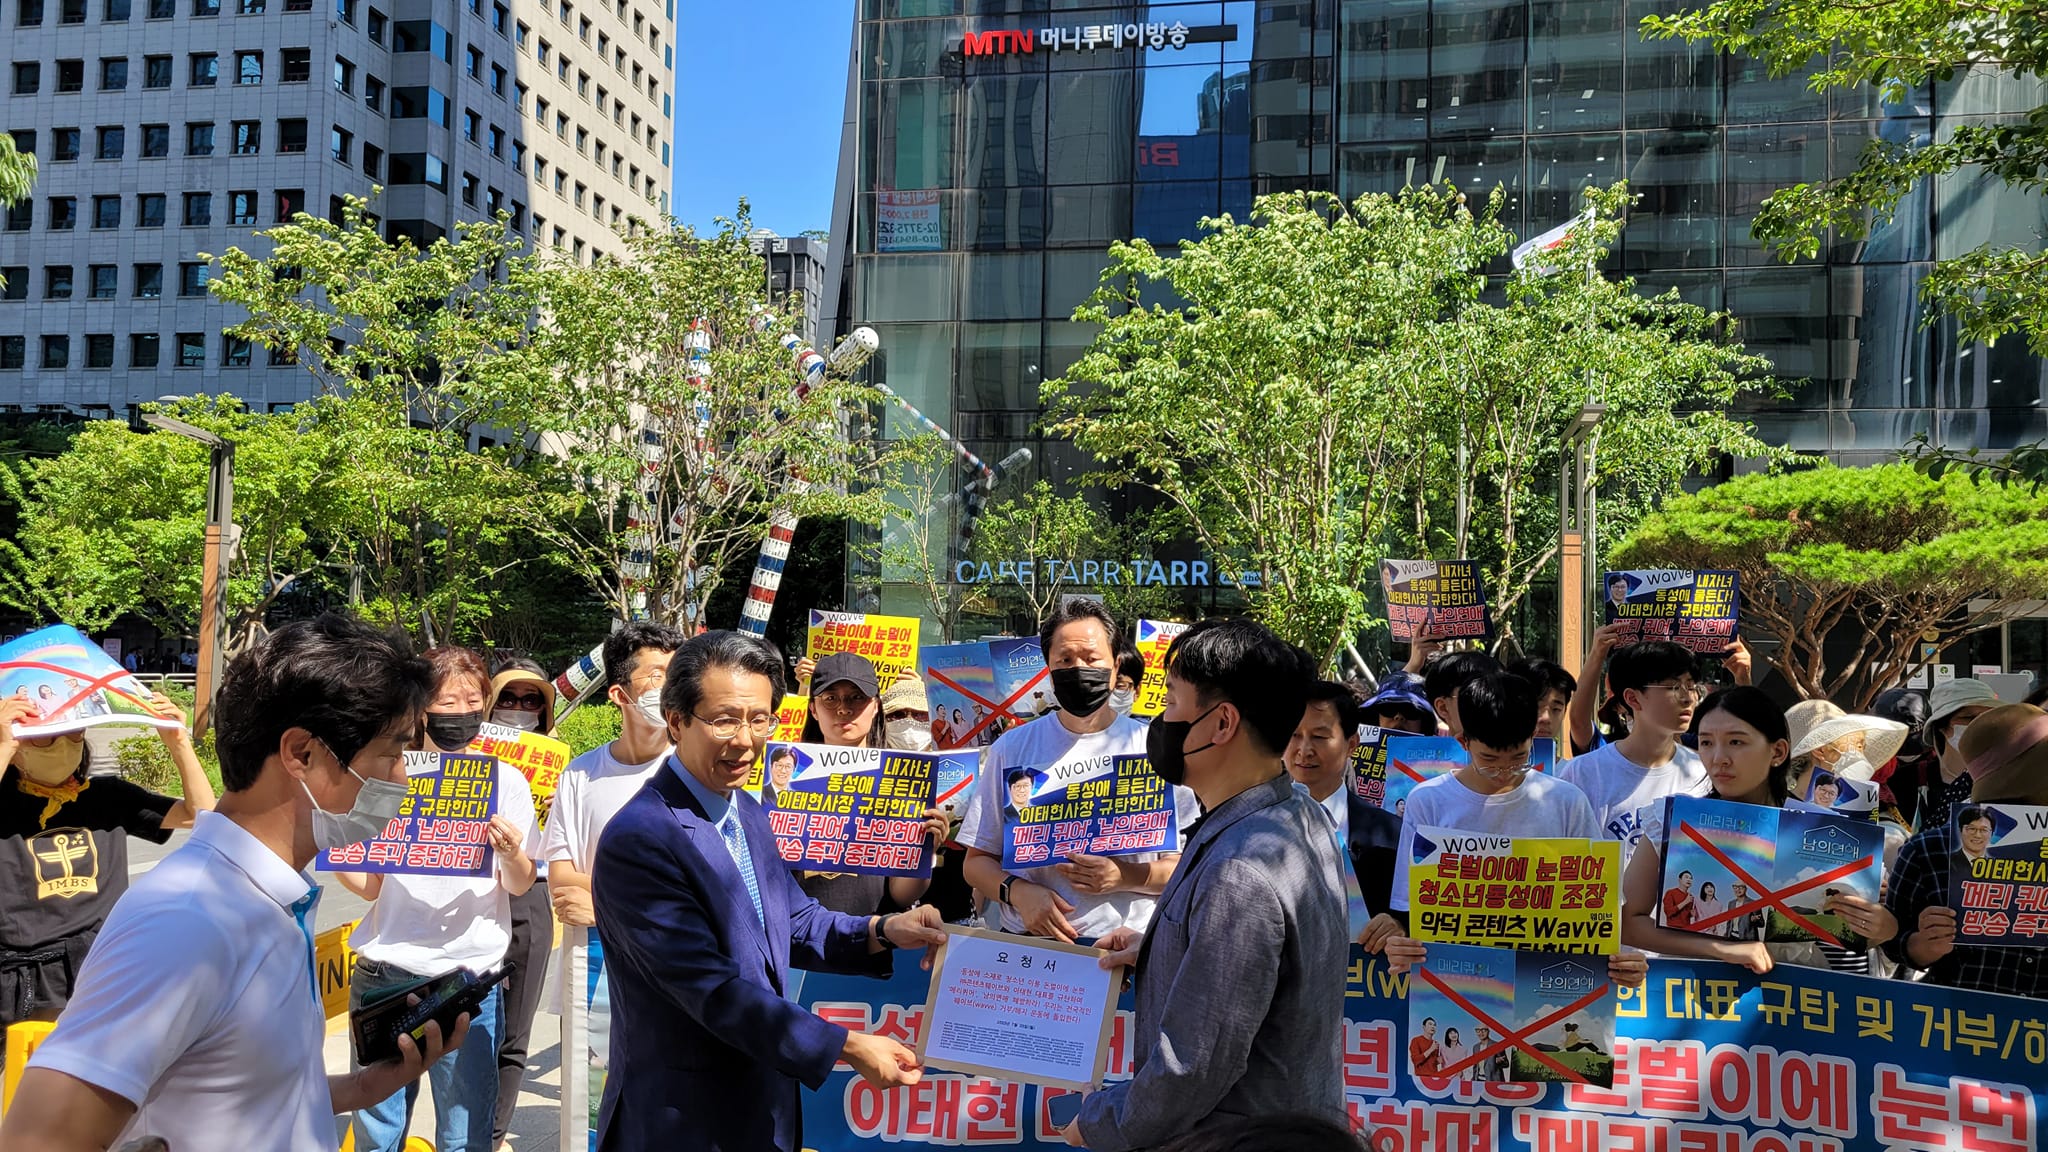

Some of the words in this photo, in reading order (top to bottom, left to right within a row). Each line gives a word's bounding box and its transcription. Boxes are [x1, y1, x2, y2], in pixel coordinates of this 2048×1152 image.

[964, 29, 1033, 55] MTN
[1041, 21, 1190, 51] 머니투데이방송
[956, 560, 1034, 584] CAFE
[1044, 560, 1121, 586] TARR
[1131, 560, 1210, 587] TARR
[1401, 560, 1436, 575] wavve
[1440, 564, 1471, 578] 내자녀
[1646, 569, 1693, 586] wavve
[1410, 578, 1437, 592] 동성애
[1440, 578, 1476, 592] 물든다!
[1696, 574, 1734, 588] 내자녀
[1388, 591, 1428, 606] 이태현사장
[1431, 592, 1477, 606] 규탄한다!
[1655, 588, 1691, 602] 동성애
[1693, 589, 1734, 602] 물든다!
[828, 613, 865, 622] wavve
[1618, 603, 1678, 617] 이태현사장
[1680, 603, 1731, 617] 규탄한다!
[823, 621, 873, 640] 돈벌이에
[875, 626, 912, 642] 눈멀어
[1678, 618, 1736, 637] '남의연애'
[886, 642, 912, 658] 조장
[777, 708, 806, 726] 멀어
[1360, 726, 1379, 736] vve
[403, 751, 439, 767] avve
[444, 758, 492, 779] 내자녀
[528, 746, 565, 771] 눈멀어
[819, 750, 879, 768] wavve
[883, 757, 932, 779] 내자녀
[1055, 754, 1112, 780] wavve
[406, 777, 434, 796] 성애
[440, 779, 493, 799] 물든다!
[827, 773, 875, 796] 동성애
[878, 776, 931, 799] 물든다!
[1066, 779, 1110, 800] 동성애
[1116, 776, 1166, 796] 물든다!
[419, 798, 488, 819] 규탄한다!
[776, 789, 854, 814] 이태현사장
[857, 796, 926, 819] 규탄한다!
[1019, 800, 1094, 824] 이태현사장
[1099, 794, 1164, 816] 규탄한다!
[417, 818, 489, 845] '남의연애
[769, 811, 805, 837] '메리
[854, 817, 927, 845] '남의연애
[1013, 823, 1050, 846] '메리
[1098, 810, 1173, 835] '남의연애'
[367, 842, 407, 866] 즉각
[407, 844, 485, 870] 중단하라!
[805, 838, 845, 865] 즉각
[845, 842, 922, 871] 중단하라!
[1014, 844, 1050, 863] 방송
[1051, 839, 1089, 858] 즉각
[1090, 830, 1166, 853] 중단하라!
[1443, 837, 1511, 853] wavve
[1802, 837, 1860, 860] 남의연애
[1437, 852, 1529, 882] 돈벌이에
[1535, 855, 1606, 882] 눈멀어
[48, 879, 89, 891] IMBS
[1418, 879, 1555, 910] 청소년동성애
[1560, 883, 1608, 910] 조장
[1961, 880, 2014, 910] '메리
[1420, 911, 1462, 937] 악덕
[1465, 913, 1526, 939] 콘텐츠
[1533, 917, 1613, 939] Wavve
[1961, 910, 2010, 937] 방송
[1539, 975, 1595, 992] 남의연애
[1665, 977, 1742, 1021] 대표
[1757, 981, 1840, 1035] 규탄
[1856, 996, 1894, 1042] 및
[850, 1078, 1017, 1141] 이태현
